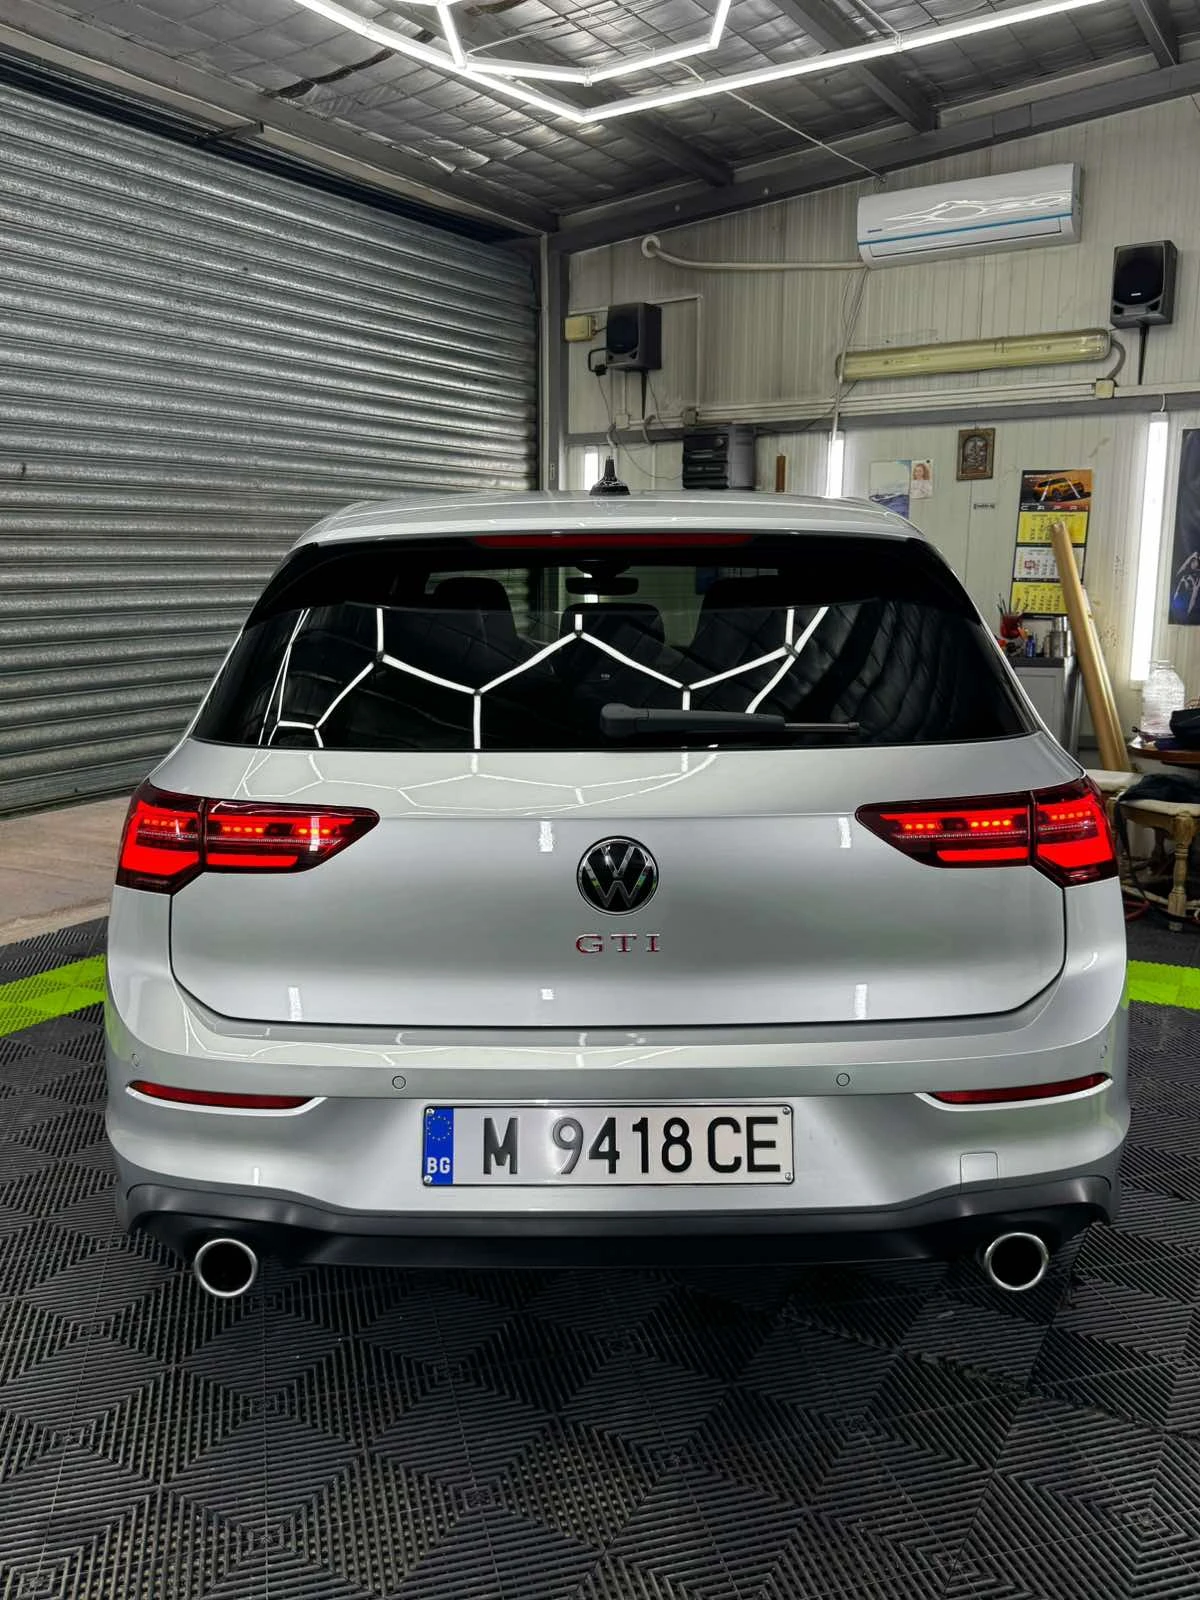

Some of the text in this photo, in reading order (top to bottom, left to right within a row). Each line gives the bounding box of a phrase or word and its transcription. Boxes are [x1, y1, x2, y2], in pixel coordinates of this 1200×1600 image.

[576, 933, 660, 953] GTI
[483, 1117, 518, 1175] M
[426, 1157, 451, 1174] BG
